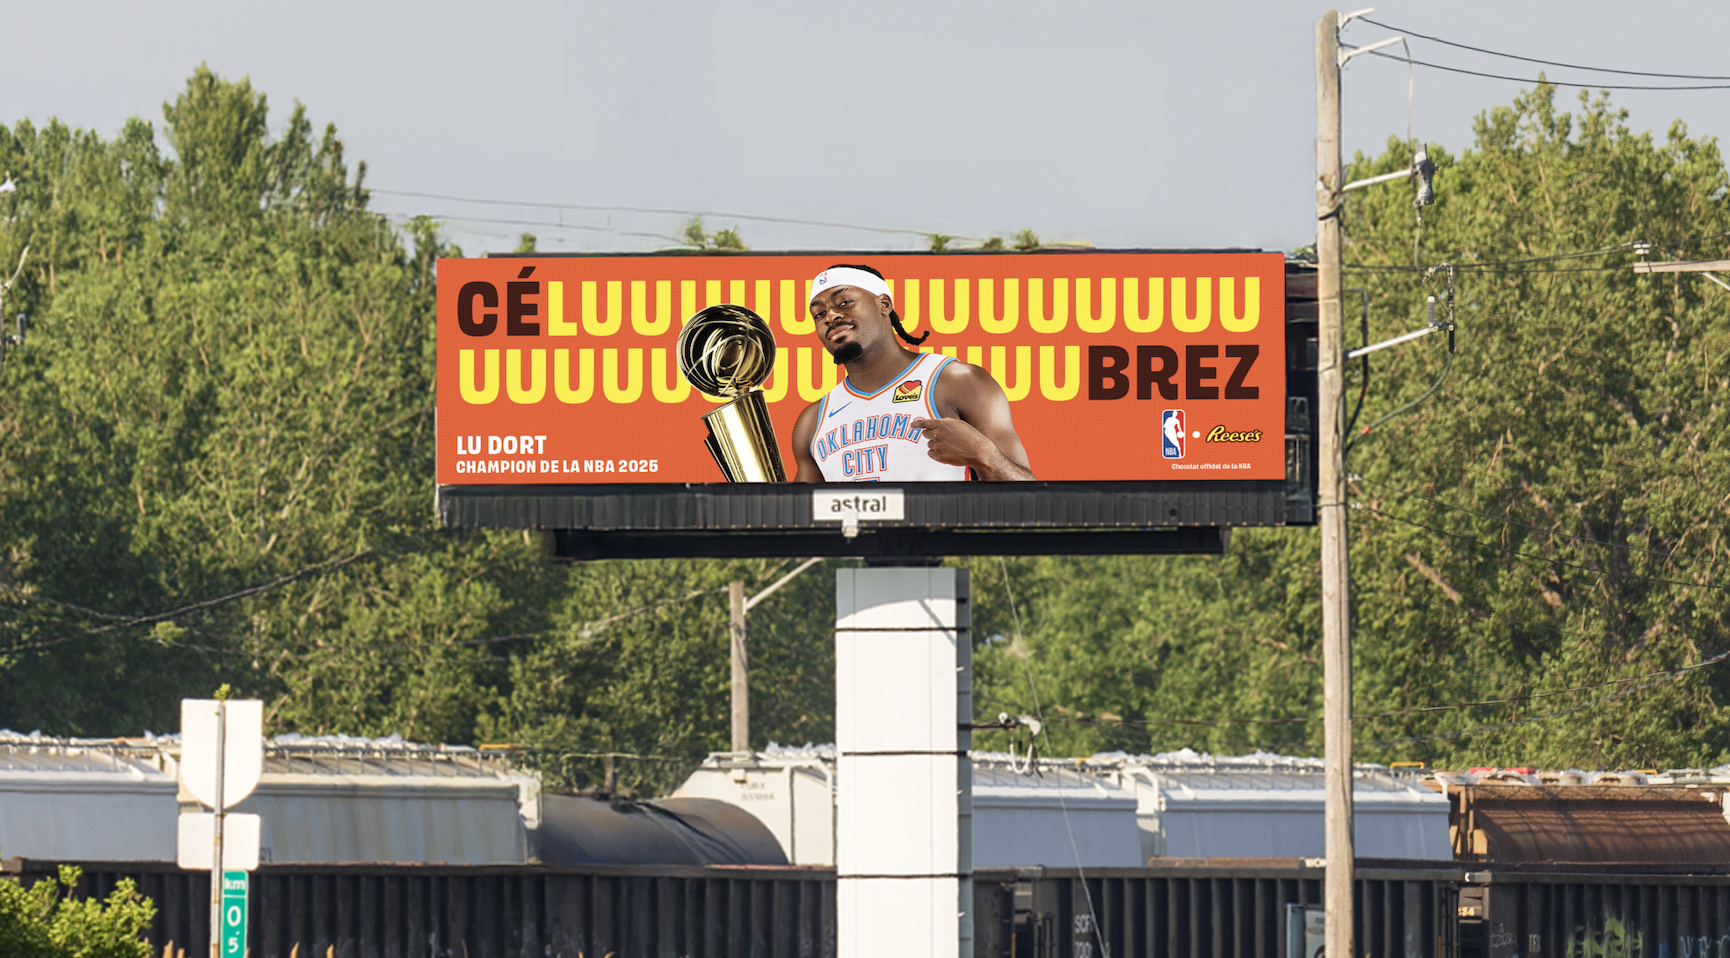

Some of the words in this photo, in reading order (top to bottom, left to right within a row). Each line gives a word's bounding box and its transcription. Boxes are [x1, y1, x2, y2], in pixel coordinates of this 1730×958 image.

[1205, 424, 1263, 443] Reese's
[456, 435, 482, 455] LU
[488, 435, 547, 455] DORT
[1165, 447, 1177, 456] NBA
[456, 460, 536, 474] CHAMPION
[540, 460, 559, 473] DE
[562, 460, 580, 473] LA
[584, 460, 615, 473] NBA
[618, 459, 659, 473] 2025
[842, 444, 888, 477] CITY
[831, 496, 887, 513] astral
[224, 878, 246, 890] km
